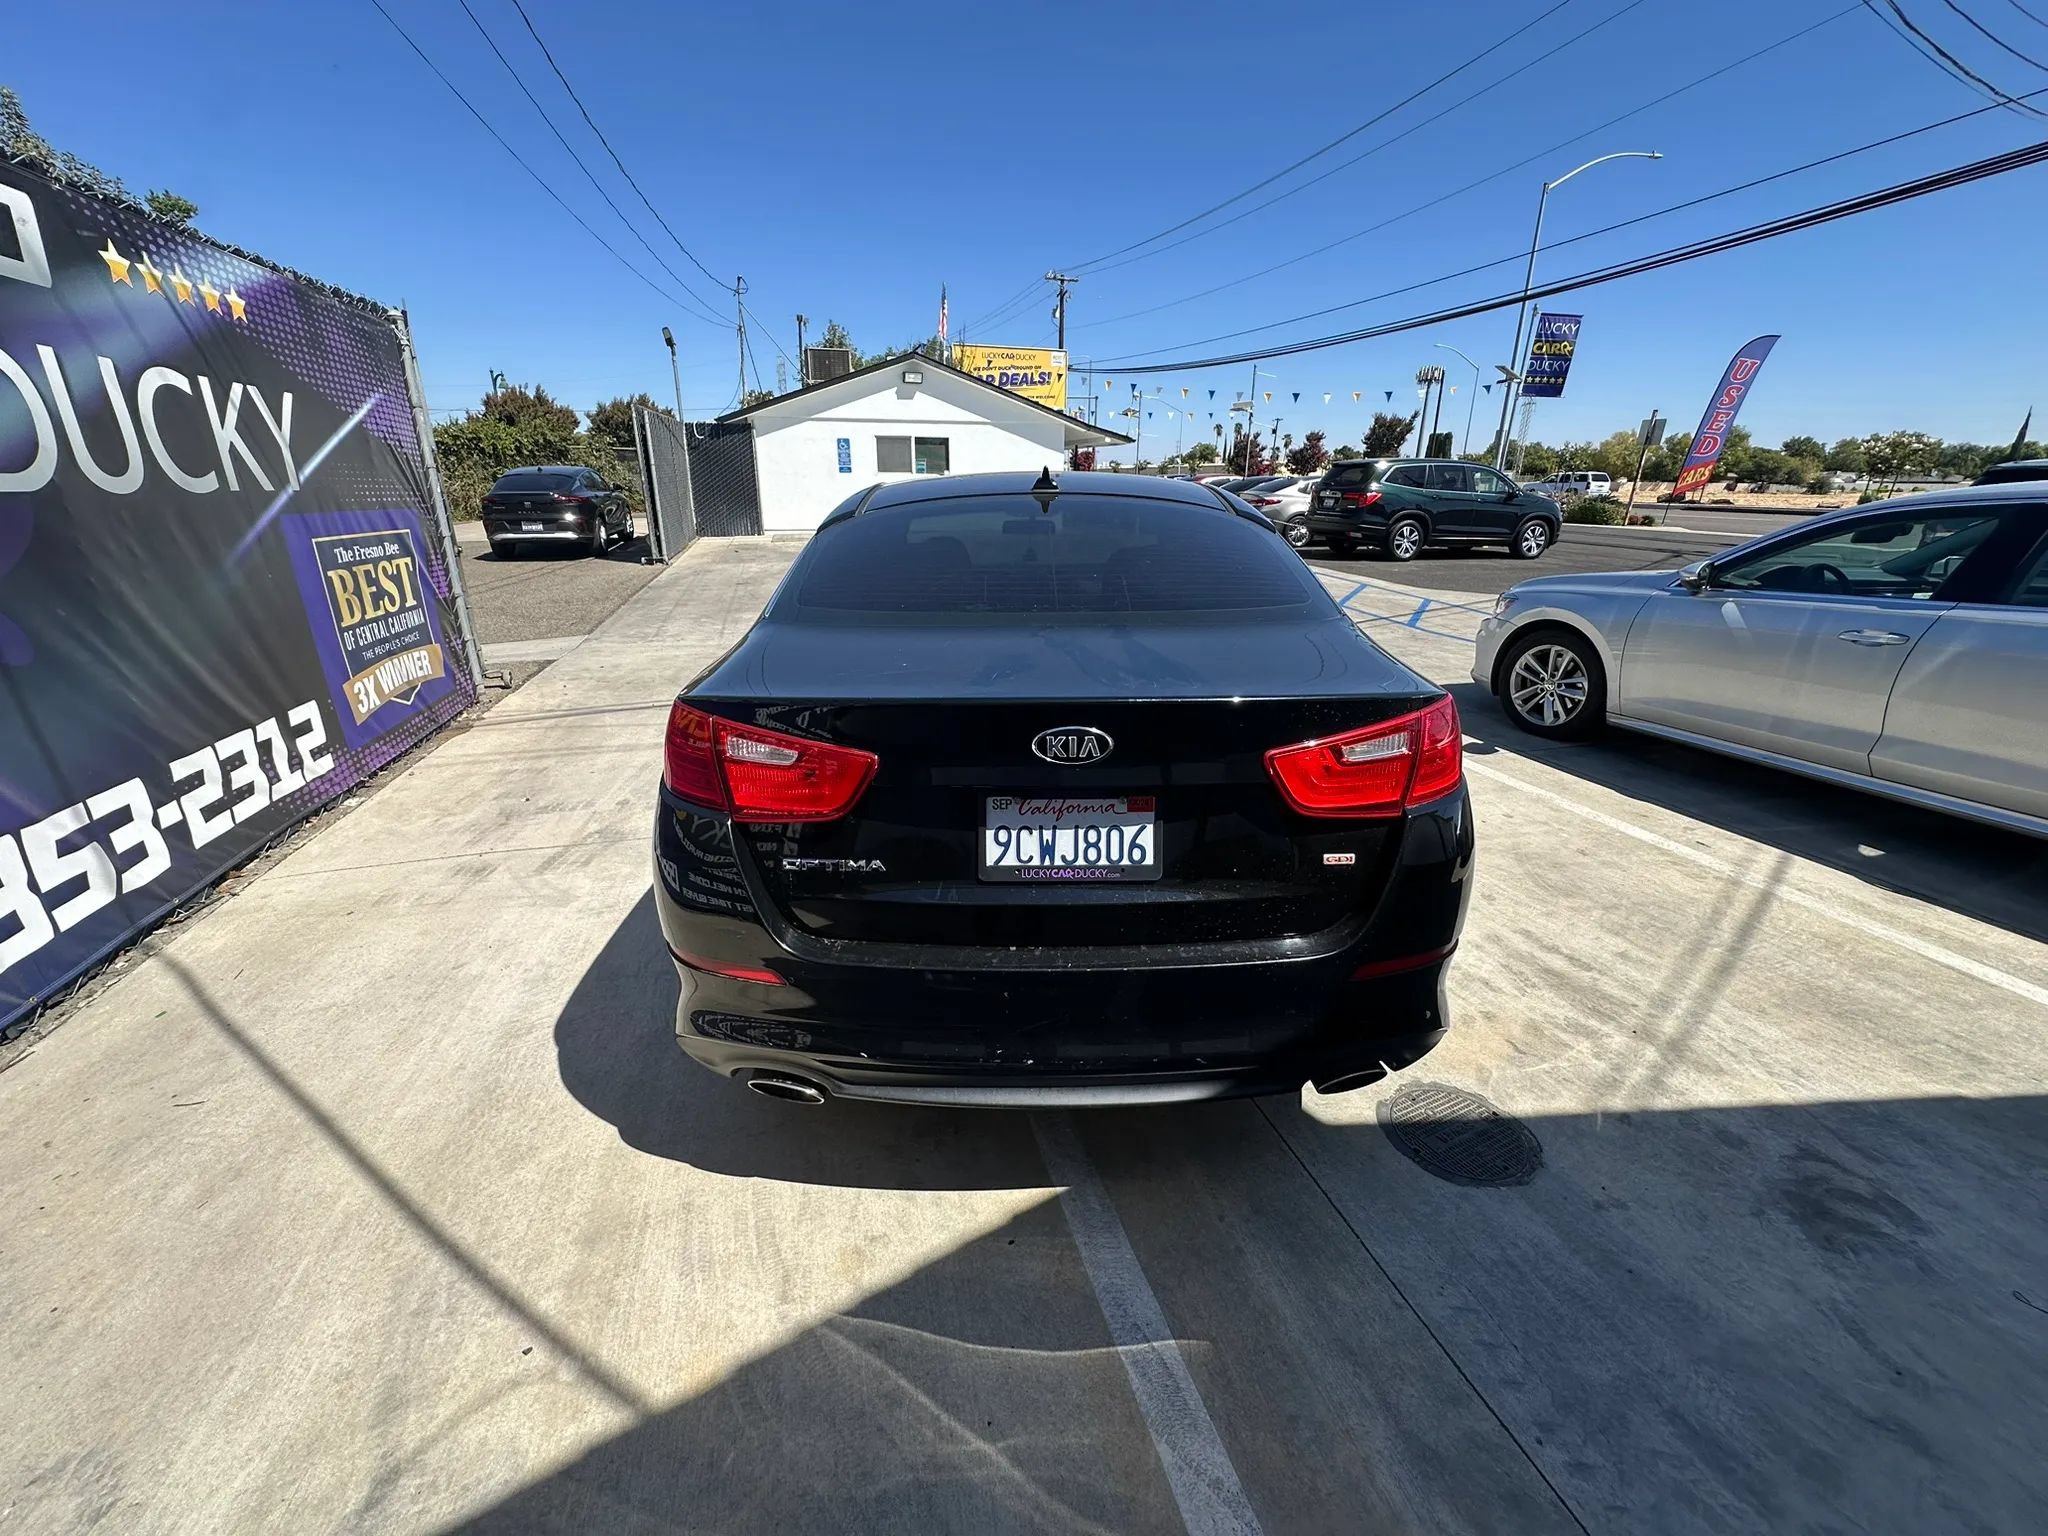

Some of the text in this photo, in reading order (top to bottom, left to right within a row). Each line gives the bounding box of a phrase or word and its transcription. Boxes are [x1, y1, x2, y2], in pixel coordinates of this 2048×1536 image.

[1539, 322, 1580, 335] LUCKY
[1528, 360, 1570, 371] DUCKY
[999, 372, 1052, 387] DEALS!
[1692, 358, 1760, 456] USED
[1678, 465, 1714, 489] CARS
[334, 542, 400, 563] The Fresno Bee
[327, 557, 417, 627] BEST
[343, 608, 425, 650] OF CENTRAL CALIFORNIA
[362, 631, 420, 660] THE PEOPLE'S CHOICE
[353, 650, 432, 714] 3X WINNER
[1046, 736, 1100, 757] KIA
[992, 799, 1013, 810] SEP
[1019, 799, 1128, 822] California
[993, 824, 1148, 866] 9CWJ806
[782, 858, 887, 872] OPTIMA
[1326, 855, 1353, 863] GDI
